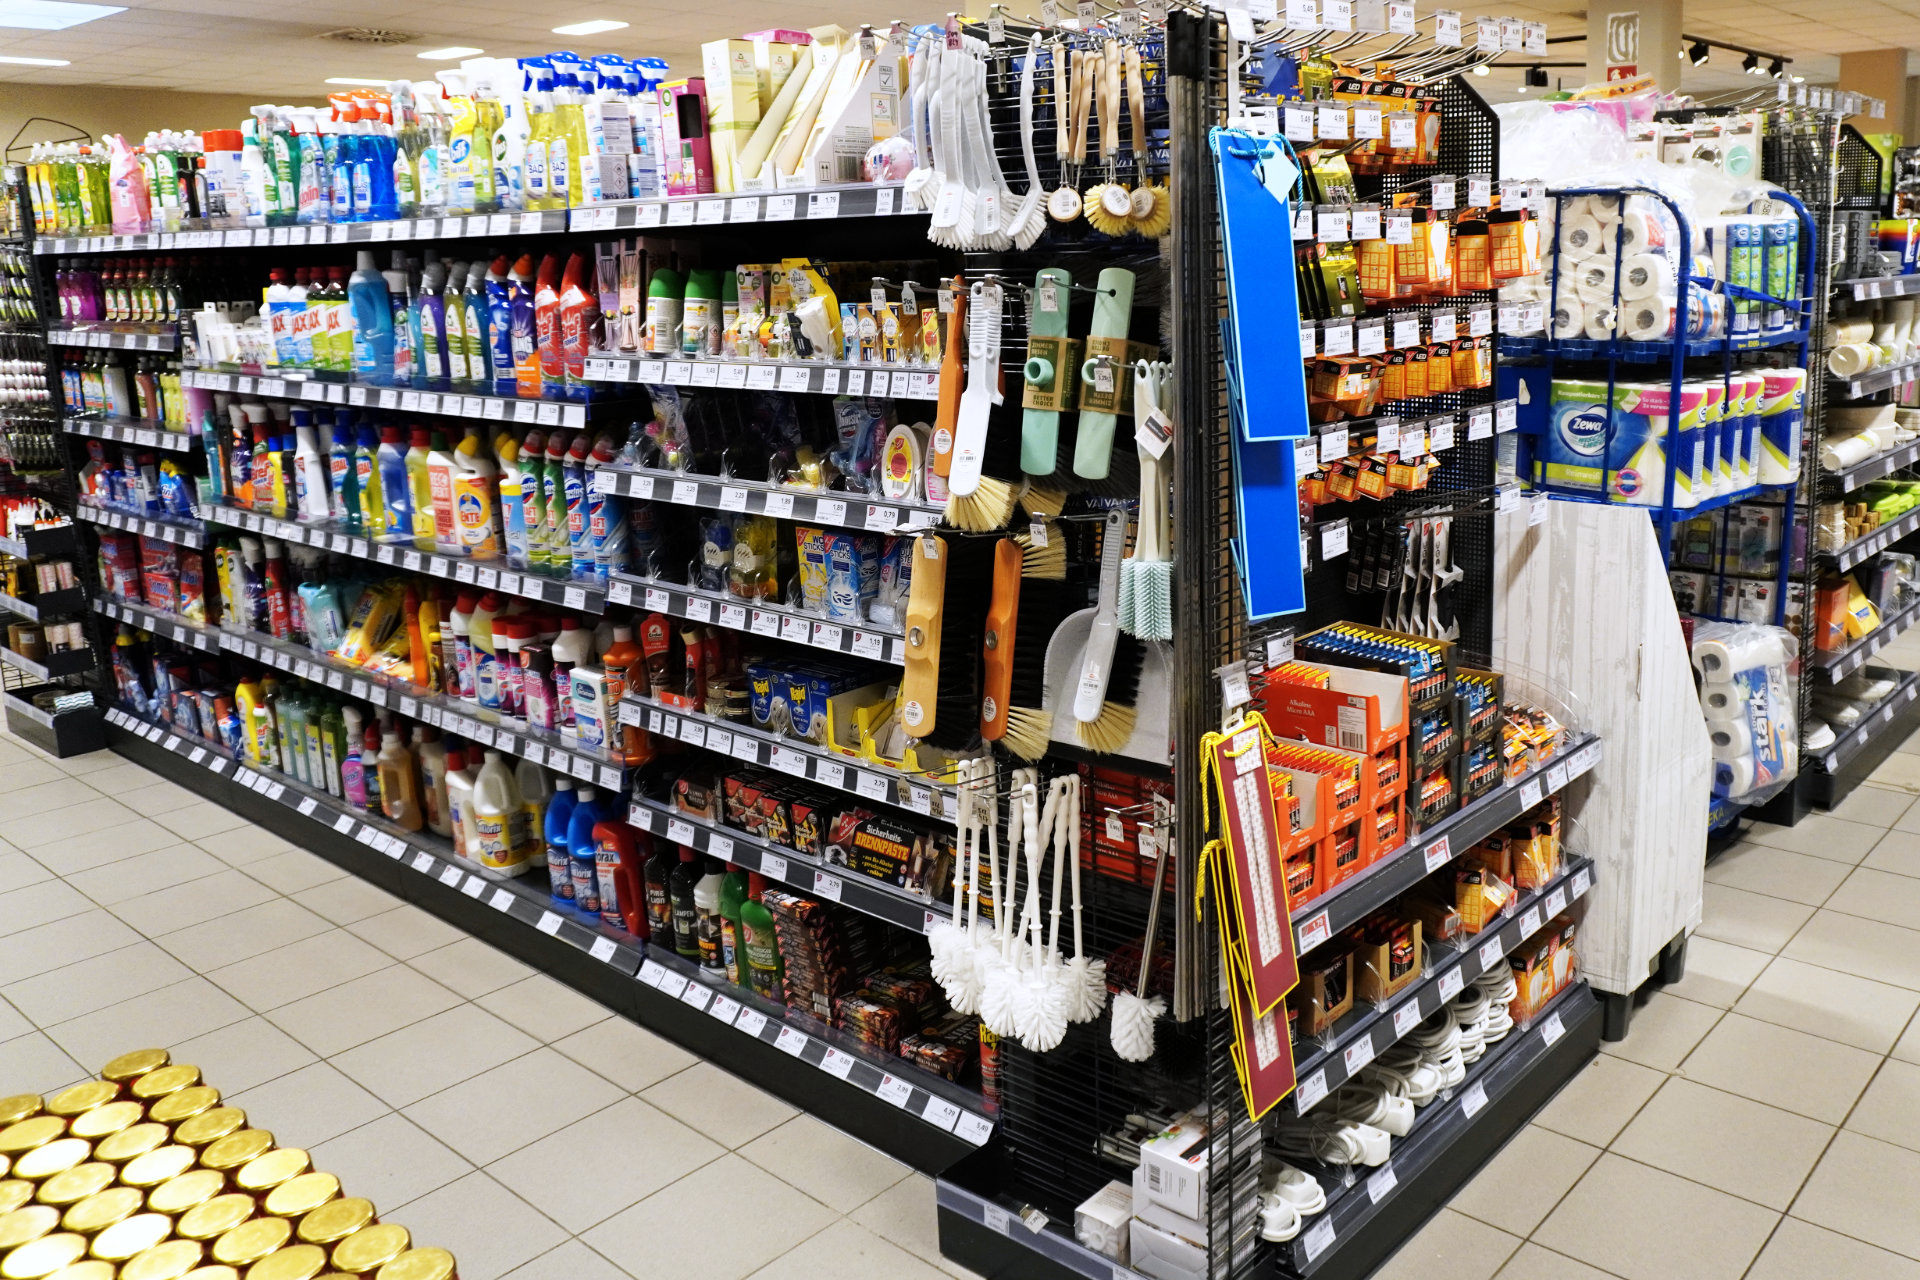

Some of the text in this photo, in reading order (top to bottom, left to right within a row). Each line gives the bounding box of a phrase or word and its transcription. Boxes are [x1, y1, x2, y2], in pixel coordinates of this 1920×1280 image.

[1573, 418, 1602, 431] Zewa
[804, 542, 824, 551] STICKS
[812, 536, 824, 544] WC
[838, 542, 850, 551] WC
[830, 550, 850, 559] STICKS
[753, 680, 769, 694] Raid
[790, 686, 805, 700] Raid
[1290, 700, 1312, 708] Alkaline
[1287, 706, 1315, 717] Micro AAA
[1750, 690, 1772, 761] stark
[866, 824, 902, 842] Sicherheits-
[854, 831, 910, 861] BRENNPASTE
[1565, 925, 1574, 938] LED
[1540, 945, 1548, 960] LED
